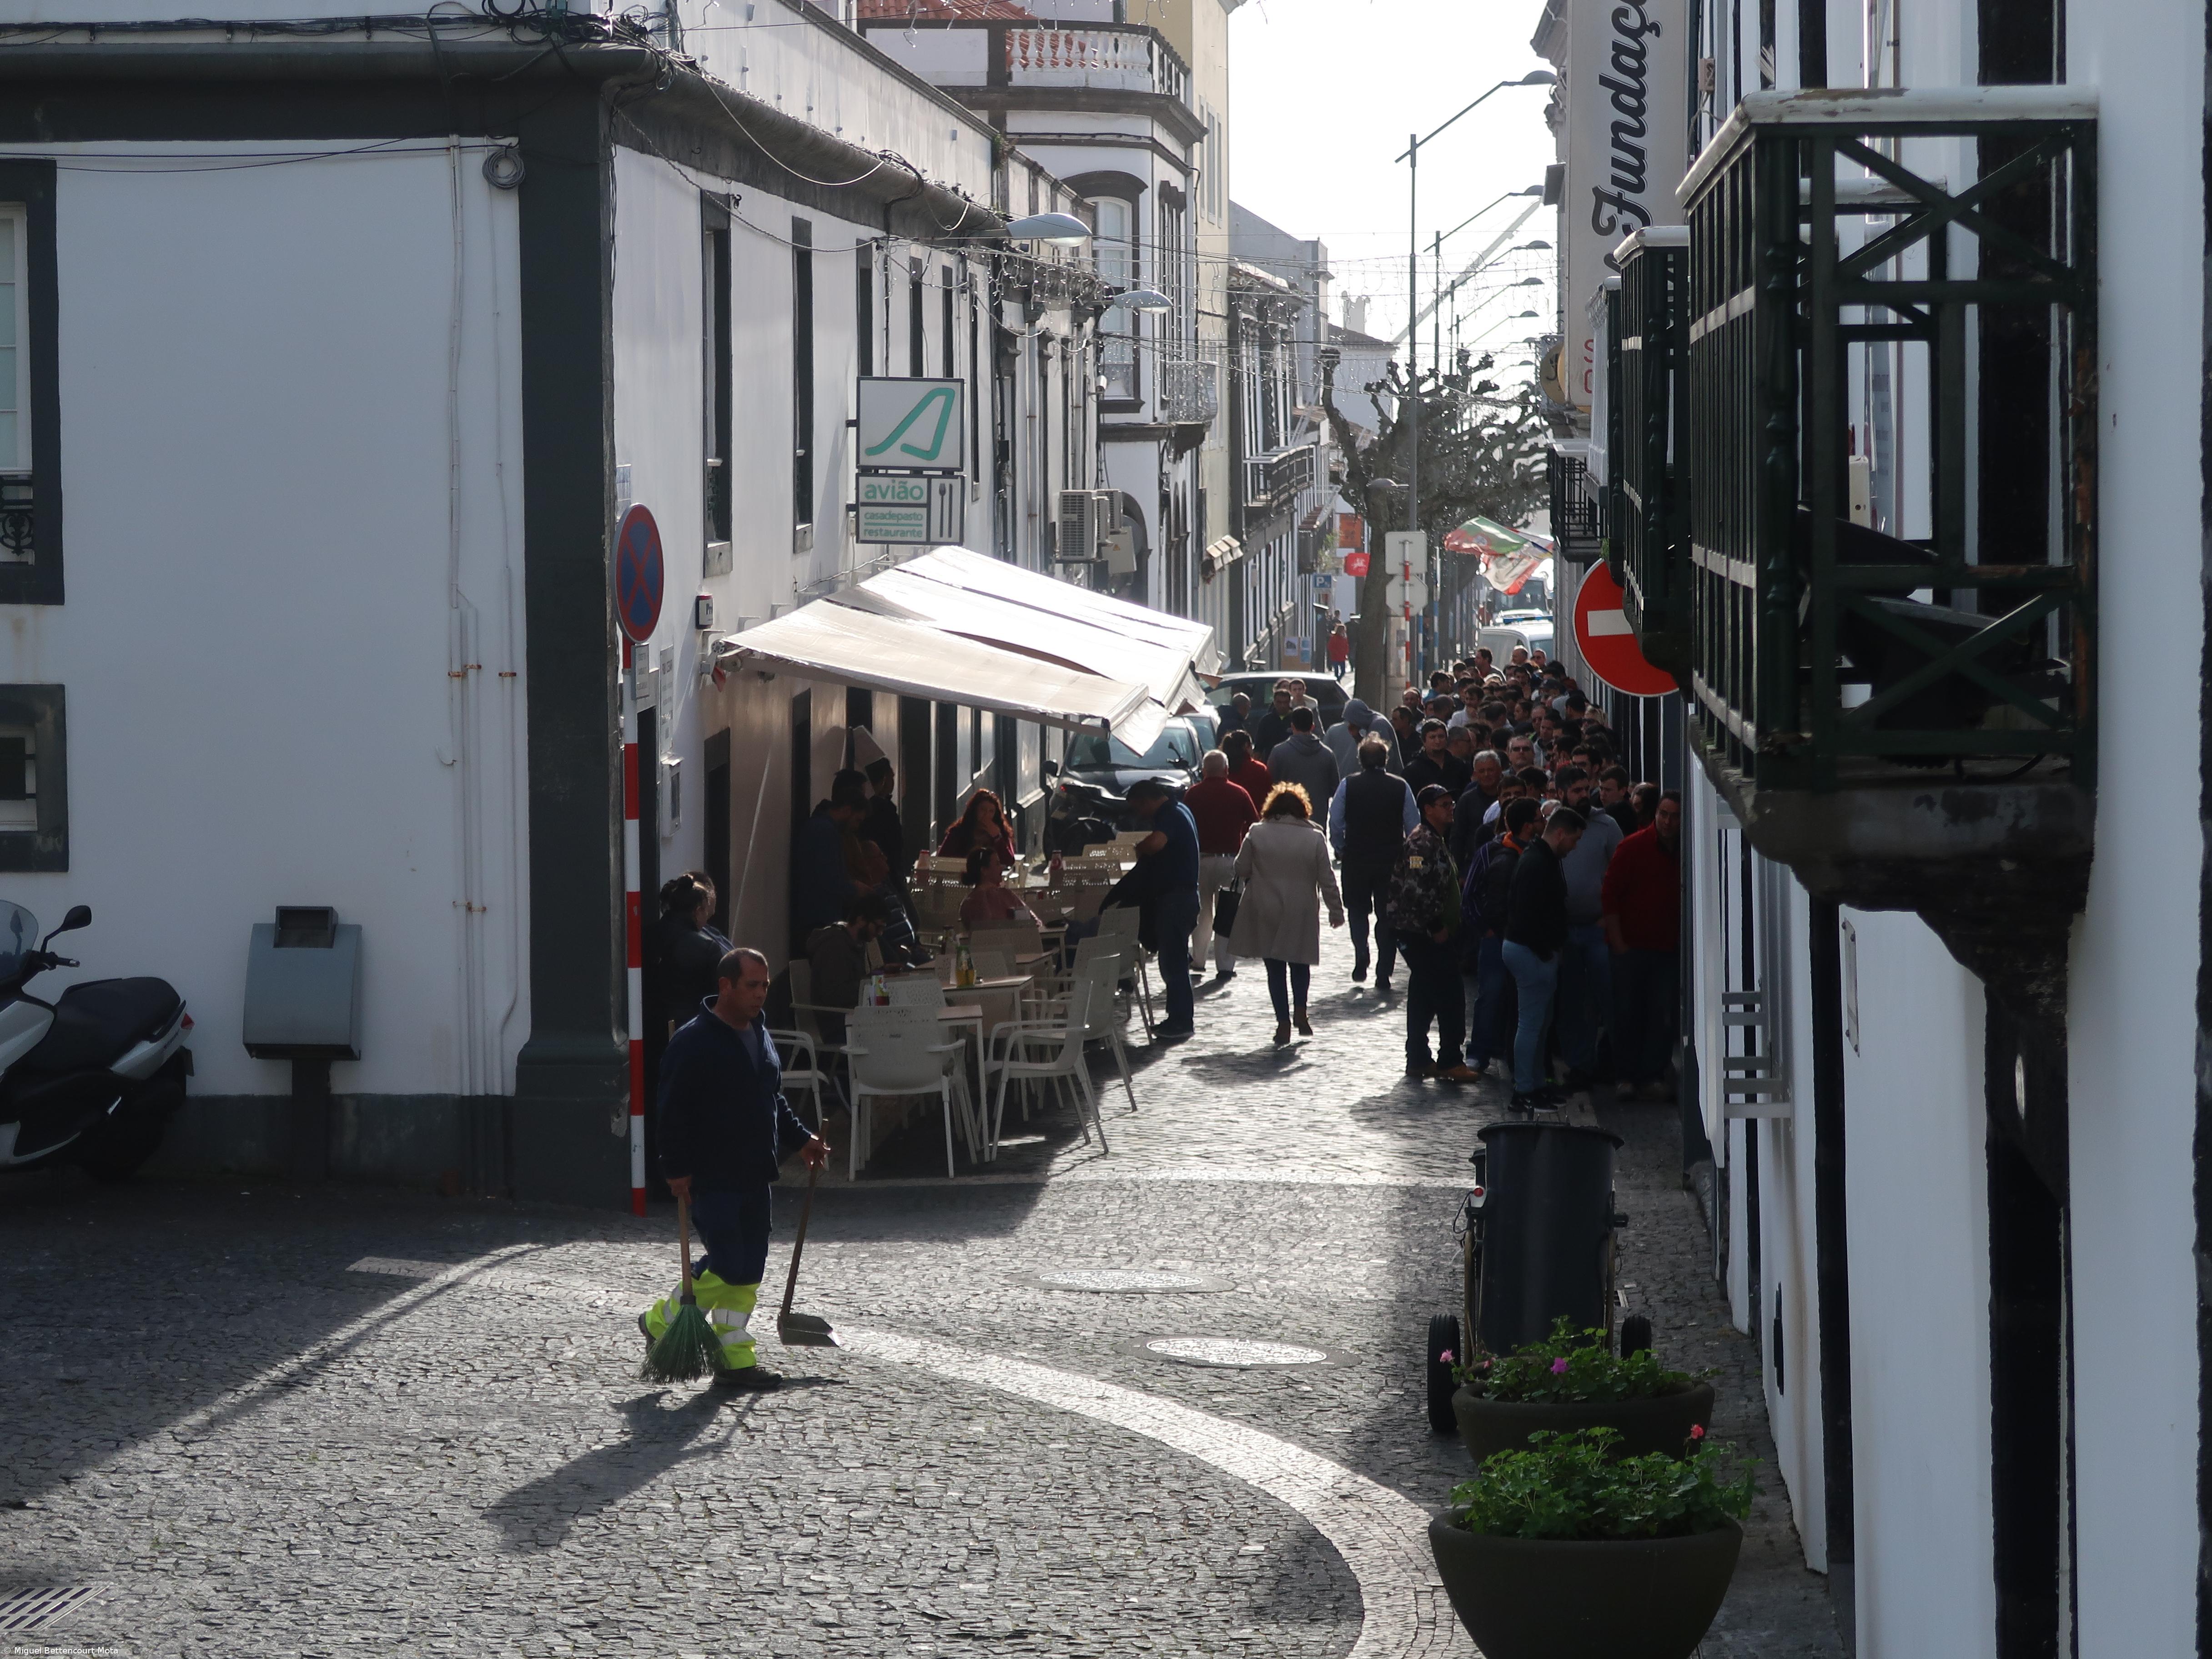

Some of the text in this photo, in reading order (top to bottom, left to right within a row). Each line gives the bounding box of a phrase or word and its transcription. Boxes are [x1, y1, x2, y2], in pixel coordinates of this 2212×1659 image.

[1592, 0, 1663, 236] Fundaç
[865, 479, 924, 500] avião
[864, 510, 923, 523] casadepasto
[864, 528, 923, 538] restaurante
[1317, 577, 1324, 587] P
